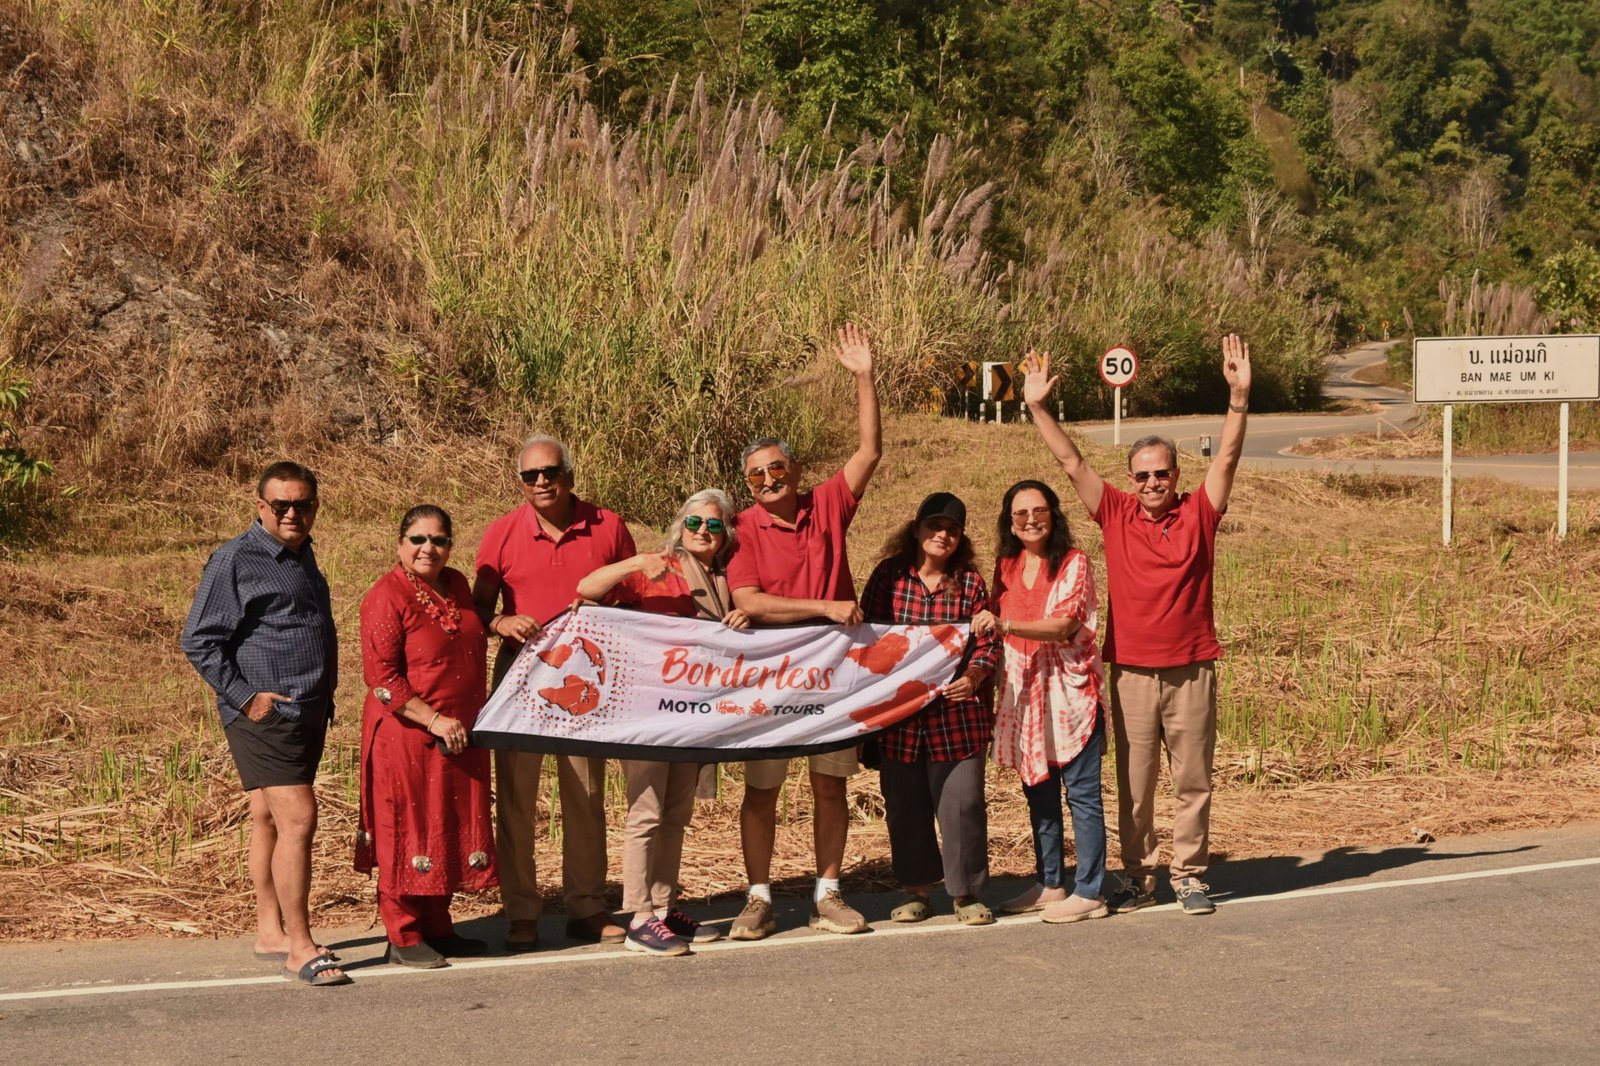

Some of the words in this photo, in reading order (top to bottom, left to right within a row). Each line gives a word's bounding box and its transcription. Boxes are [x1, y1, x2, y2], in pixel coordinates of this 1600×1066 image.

[1469, 349, 1484, 365] บ.
[1490, 342, 1547, 364] แม่อมกิ
[1105, 357, 1133, 376] 50
[1460, 372, 1482, 383] BAN
[1489, 371, 1512, 382] MAE
[1520, 371, 1536, 382] UM
[1544, 370, 1555, 381] KI
[661, 647, 835, 691] Borderless
[658, 698, 712, 715] MOTO
[773, 703, 826, 716] TOURS
